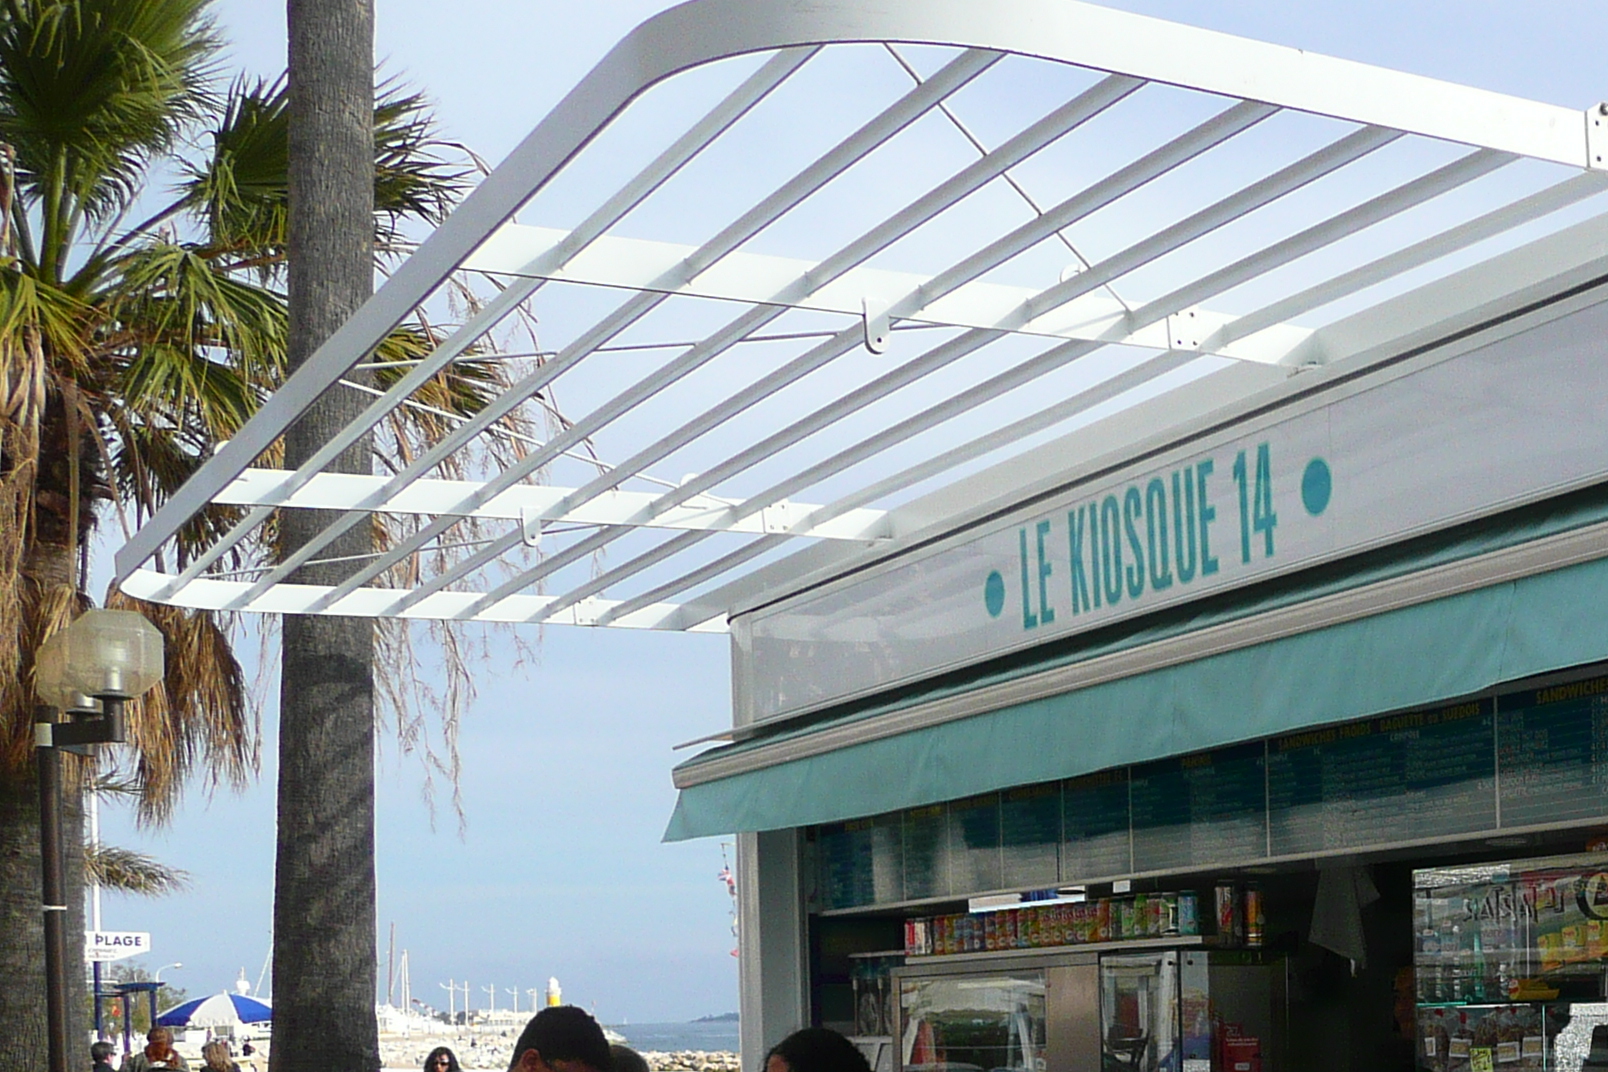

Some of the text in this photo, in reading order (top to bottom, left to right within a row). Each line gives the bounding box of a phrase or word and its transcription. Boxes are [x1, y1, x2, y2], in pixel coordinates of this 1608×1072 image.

[1019, 440, 1278, 630] LE KIOSQUE 14
[95, 934, 142, 947] PLAGE
